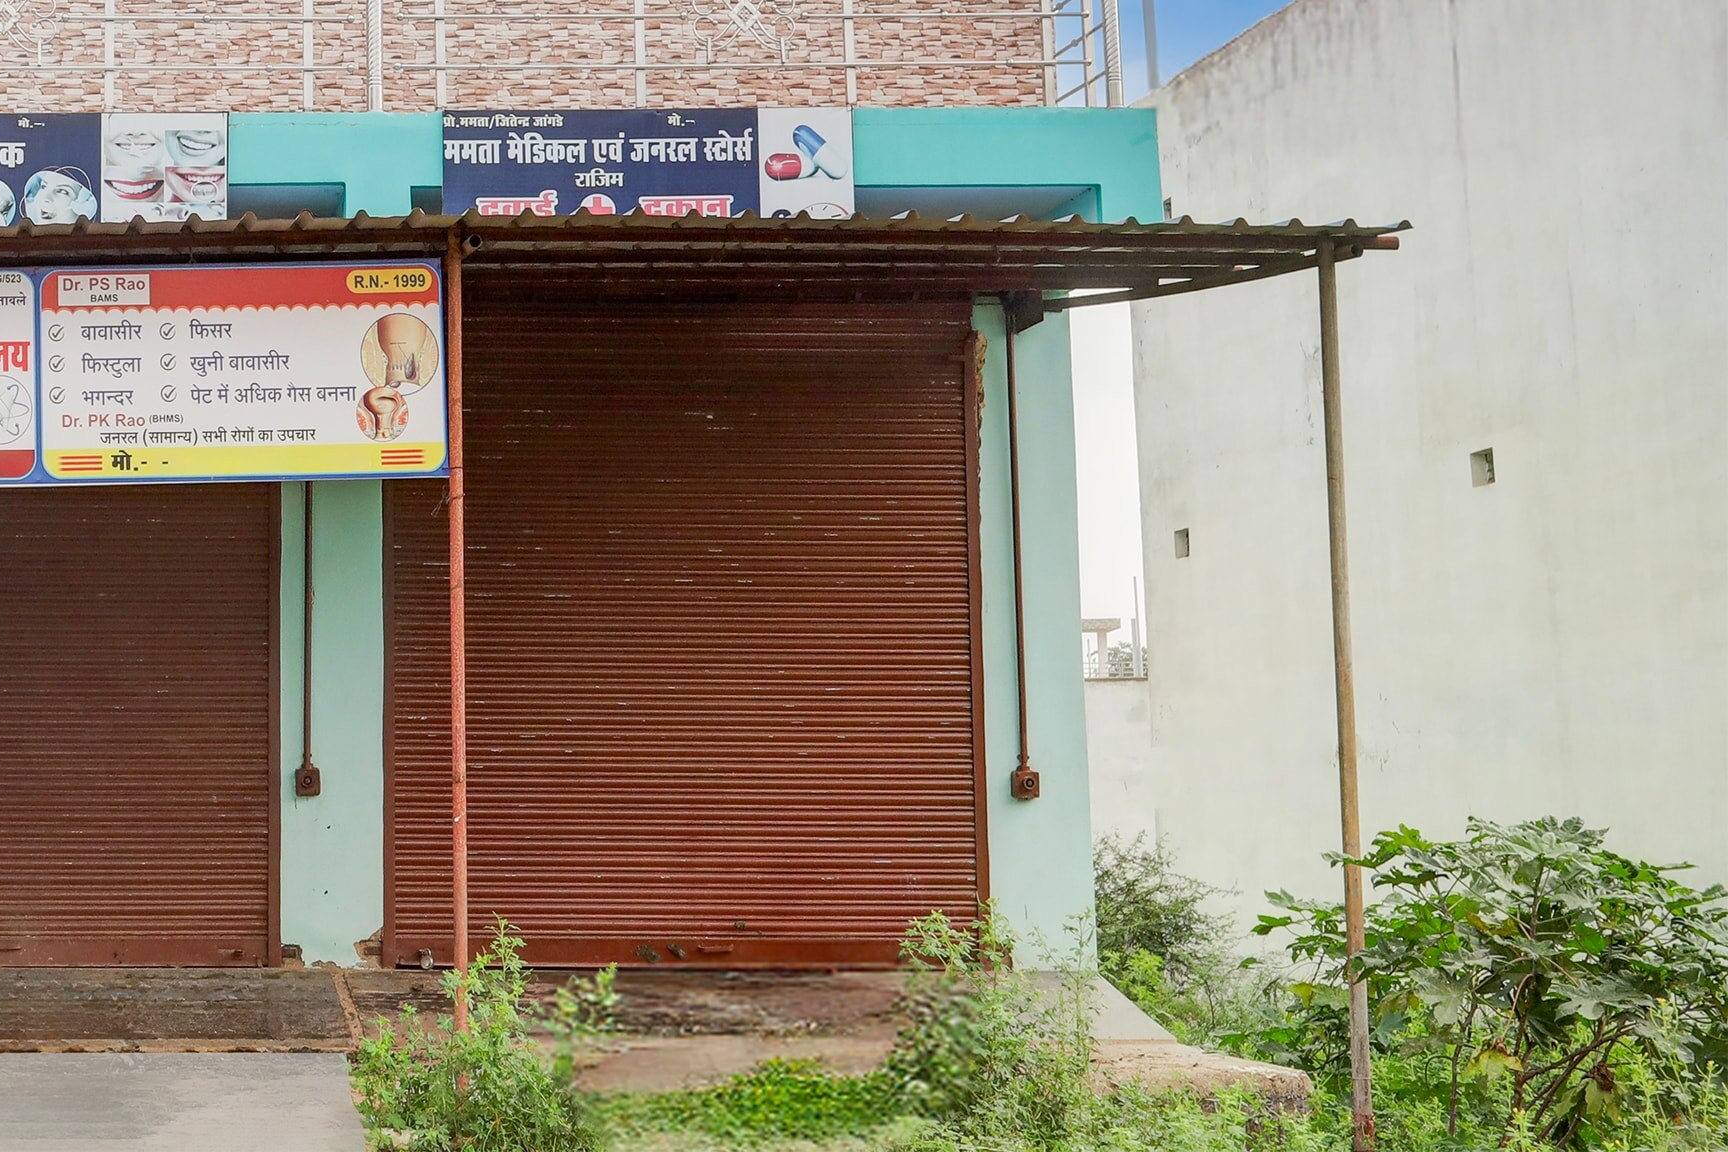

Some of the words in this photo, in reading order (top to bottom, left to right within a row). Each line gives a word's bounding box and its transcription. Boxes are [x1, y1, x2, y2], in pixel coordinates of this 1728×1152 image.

[443, 139, 503, 164] ममता
[506, 131, 588, 164] मेडिकल
[591, 131, 626, 164] एवं
[629, 137, 699, 163] जनरल
[702, 127, 754, 162] स्टोर्स
[574, 167, 624, 188] राजिम
[62, 278, 84, 292] Dr.
[89, 277, 110, 291] PS
[115, 277, 146, 291] Rao
[392, 273, 426, 288] 1999
[90, 293, 119, 303] BAMS
[81, 319, 142, 340] बावासीर
[189, 318, 233, 340] फिसर
[81, 352, 142, 379] फिस्टुला
[190, 350, 224, 378] खुनी
[228, 350, 290, 372] बावासीर
[81, 389, 134, 406] भगन्दर
[190, 384, 213, 405] पेट
[217, 383, 230, 404] में
[233, 382, 283, 404] अधिक
[286, 383, 312, 403] गैस
[316, 385, 357, 402] बनना
[61, 414, 83, 428] Dr.
[88, 414, 110, 427] PK
[115, 413, 146, 427] Rao
[148, 413, 184, 425] (BHMS)
[100, 431, 138, 446] जनरल
[142, 428, 199, 447] (सामान्य)
[202, 426, 228, 444] सभी
[231, 426, 255, 443] रोगों
[258, 429, 274, 443] का
[277, 429, 317, 442] उपचार
